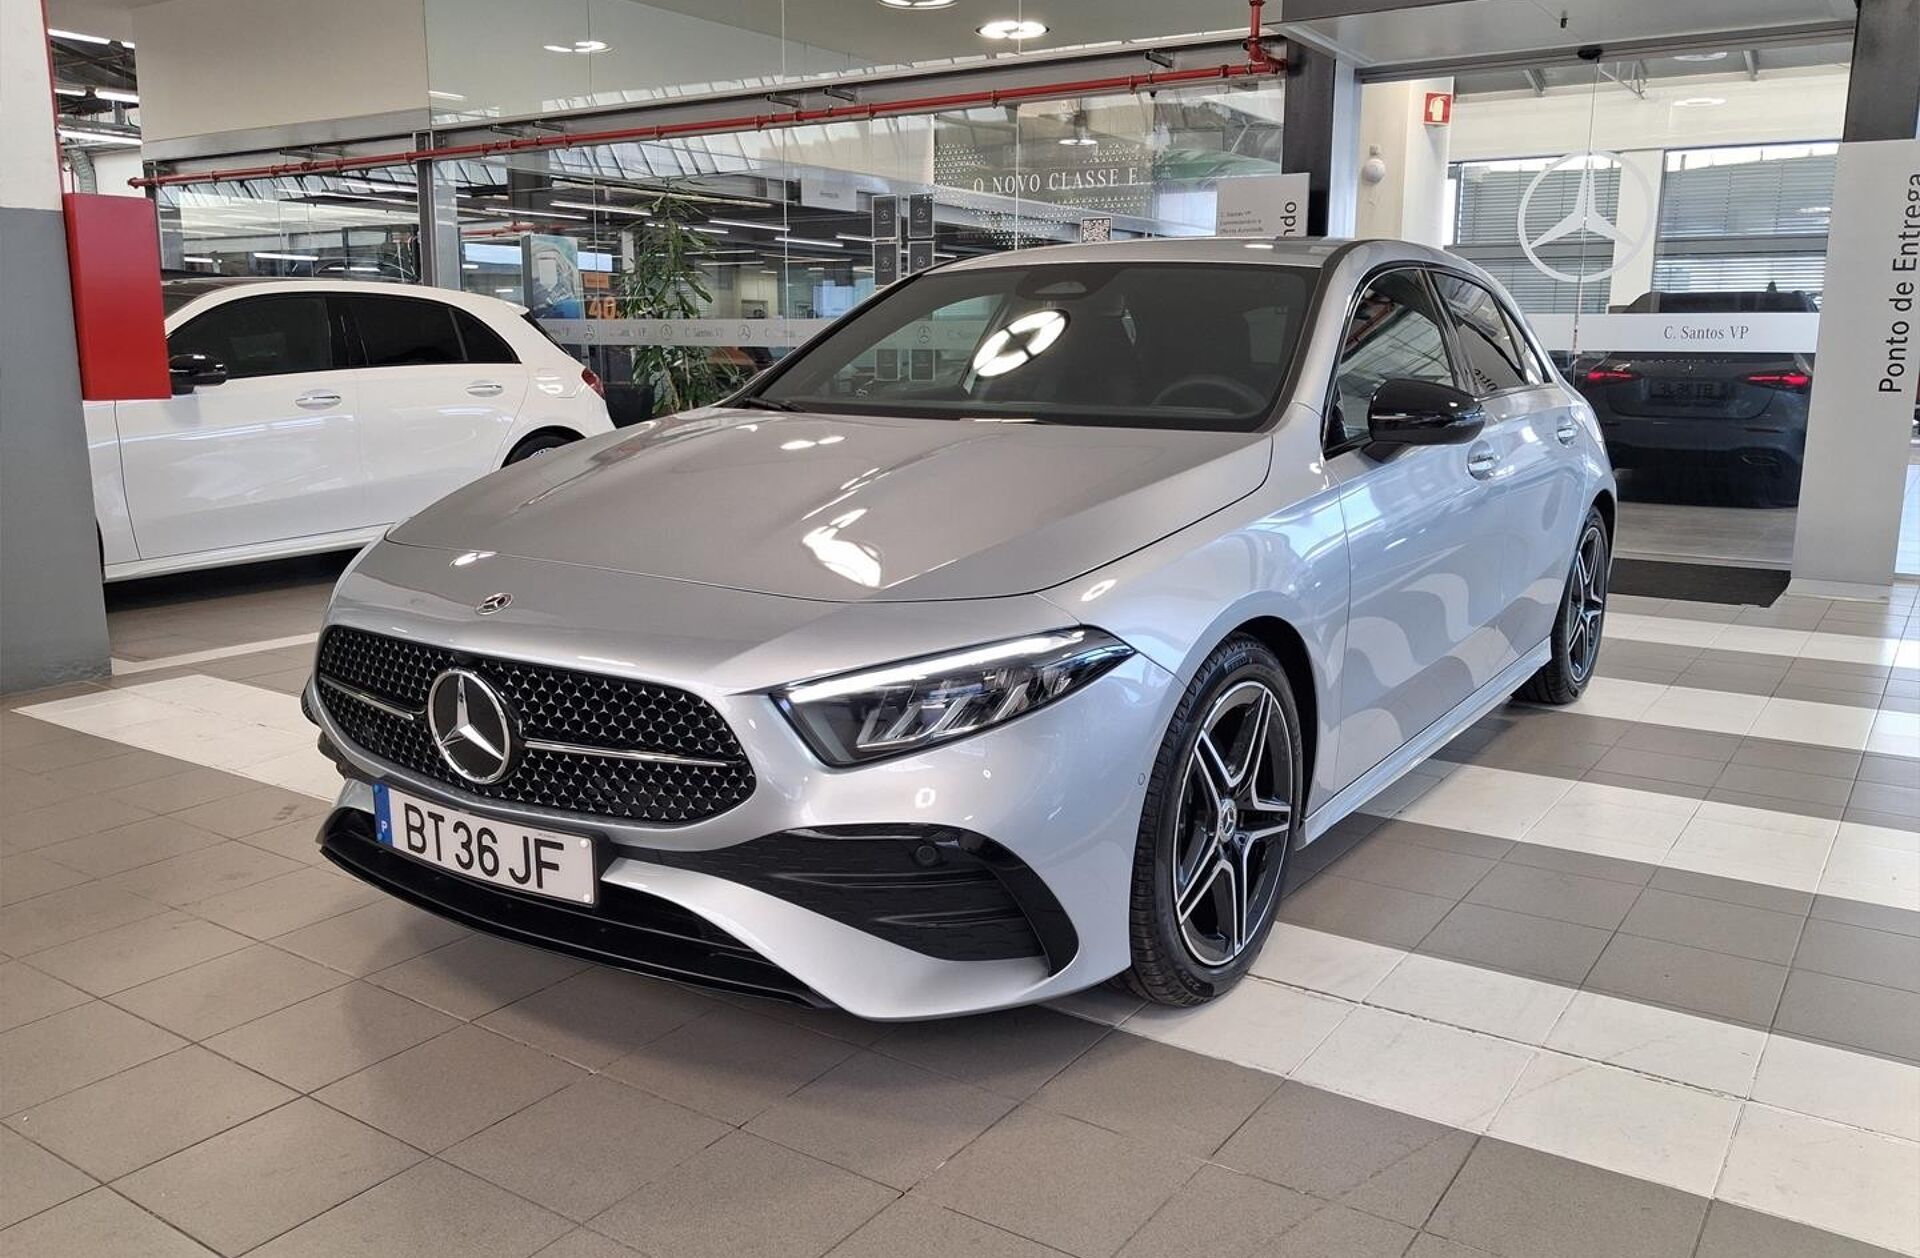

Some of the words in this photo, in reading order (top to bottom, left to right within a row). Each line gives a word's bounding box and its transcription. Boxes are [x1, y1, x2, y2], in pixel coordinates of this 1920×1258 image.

[973, 177, 985, 193] O
[992, 173, 1041, 195] NOVO
[1049, 168, 1119, 191] CLASSE
[1128, 167, 1139, 186] E
[1892, 173, 1920, 272] Entrega
[1888, 282, 1915, 312] de
[1663, 325, 1676, 340] C.
[1681, 325, 1725, 341] Santos
[1730, 325, 1749, 340] VP
[1878, 321, 1910, 393] Ponto
[381, 820, 388, 833] P
[404, 802, 445, 862] BT
[453, 820, 500, 877] 36
[508, 836, 565, 889] JF
